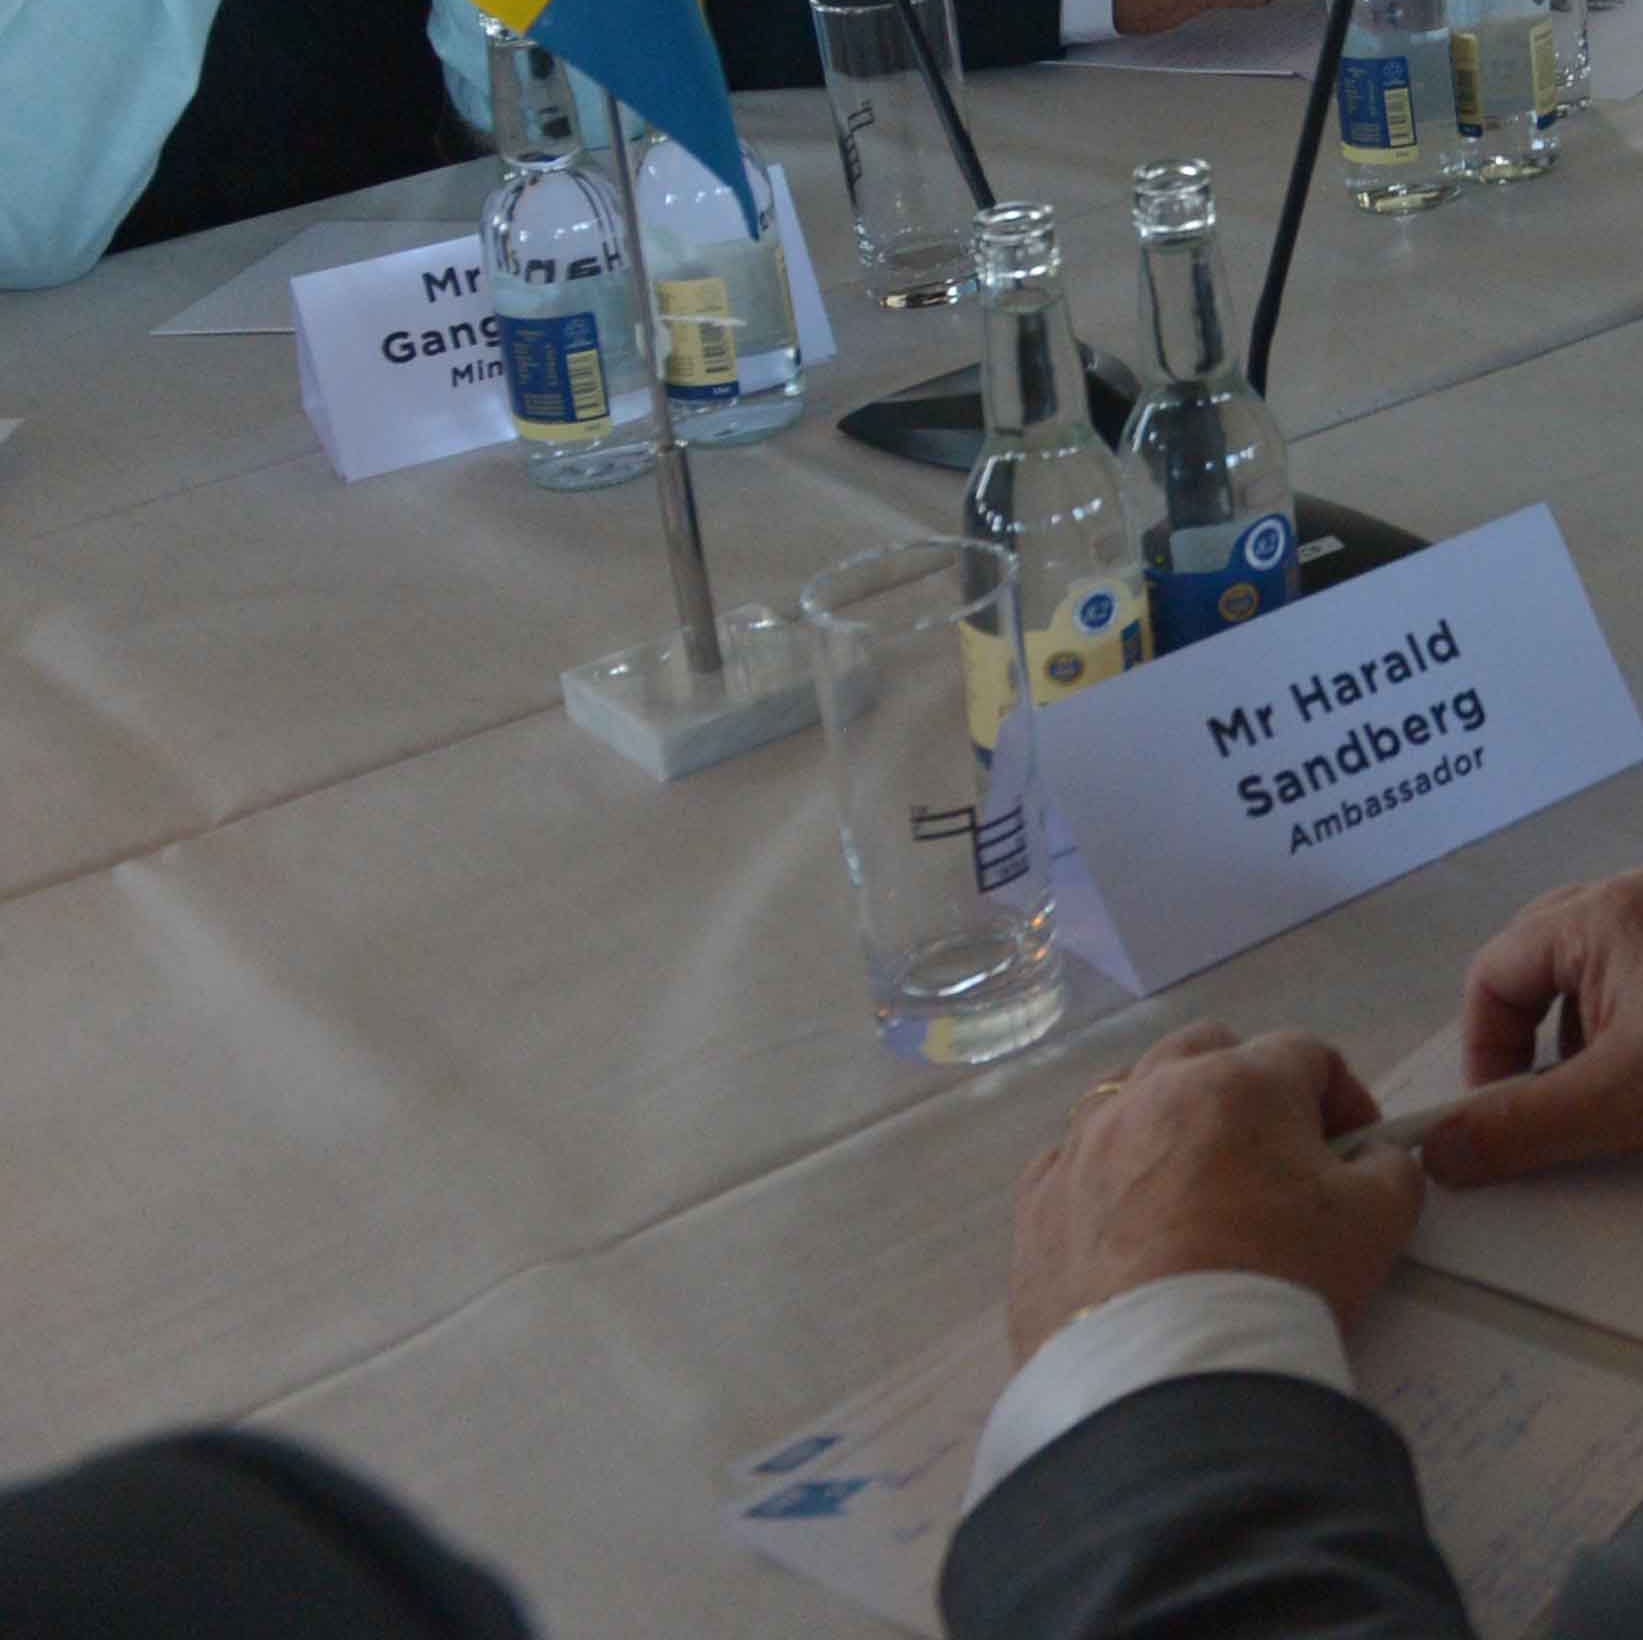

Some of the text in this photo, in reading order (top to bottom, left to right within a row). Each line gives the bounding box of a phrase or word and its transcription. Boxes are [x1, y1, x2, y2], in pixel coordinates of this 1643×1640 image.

[421, 265, 482, 304] Mr
[381, 314, 504, 363] Gang
[451, 358, 505, 388] Min
[1206, 618, 1461, 758] Mr Harald
[1236, 687, 1487, 818] Sandberg
[1289, 746, 1485, 856] Ambassador
